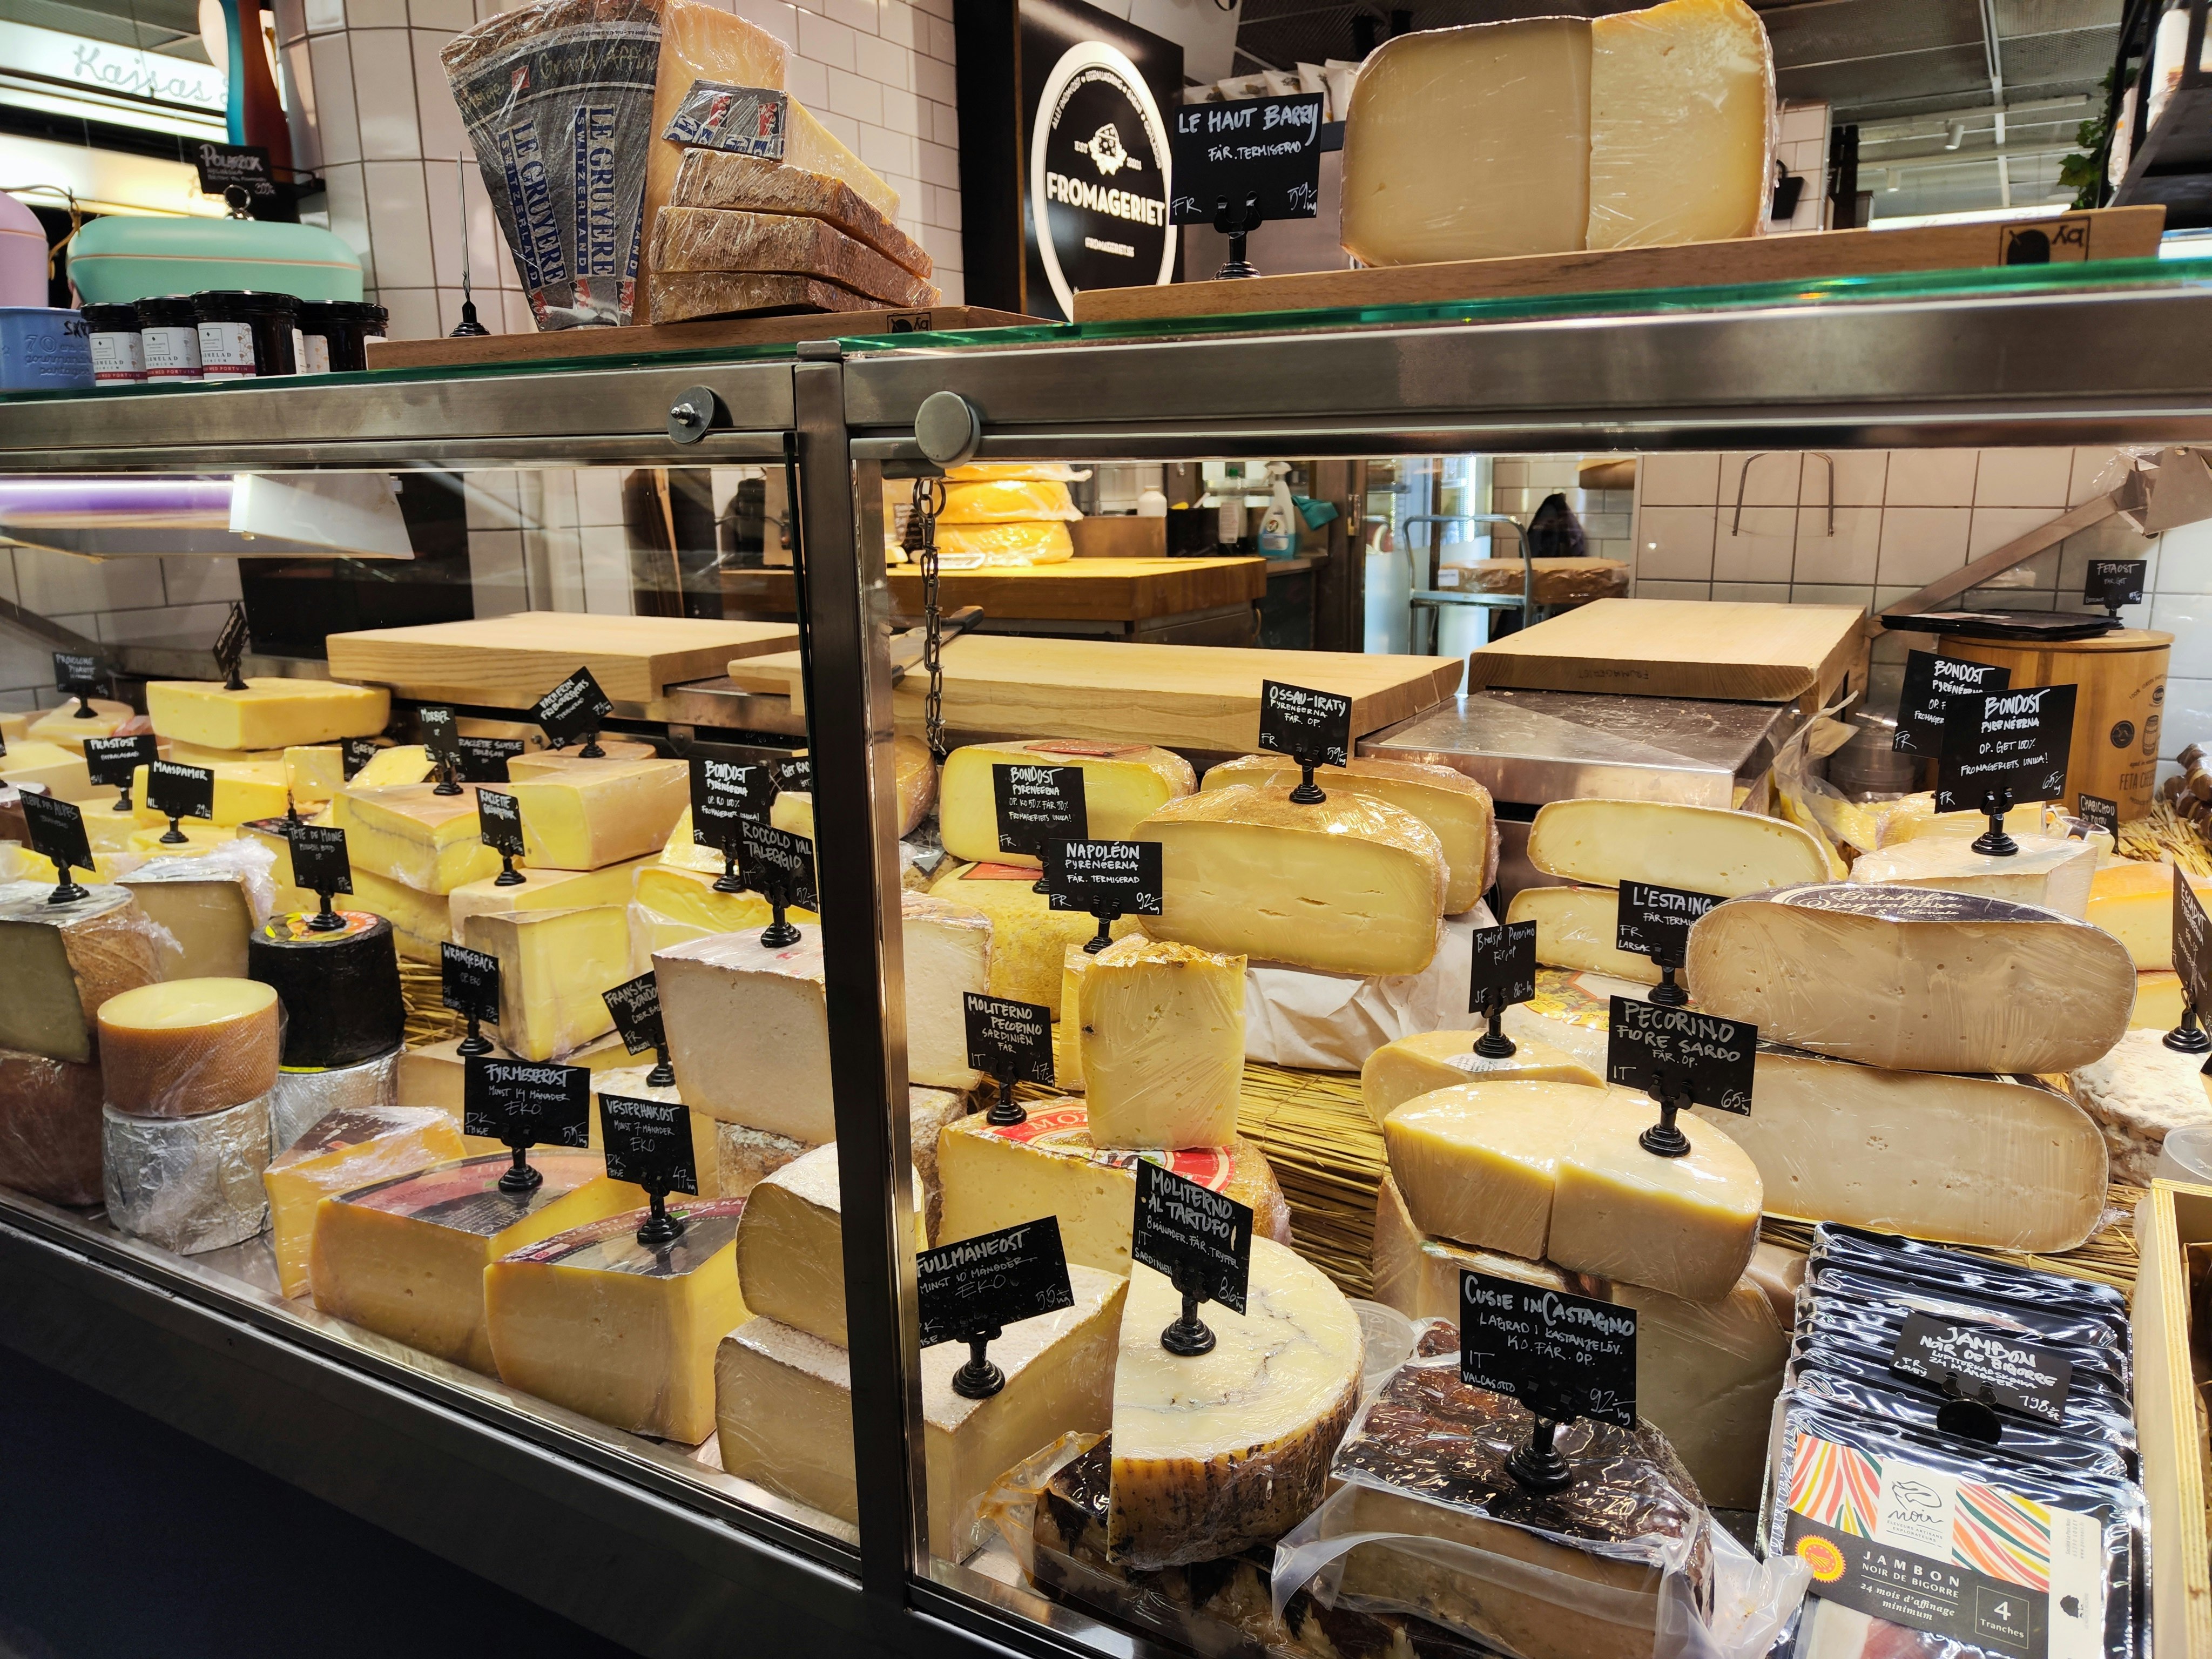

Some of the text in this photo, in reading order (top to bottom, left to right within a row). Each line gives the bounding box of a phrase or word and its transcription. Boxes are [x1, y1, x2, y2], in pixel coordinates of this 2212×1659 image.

[73, 44, 212, 102] Kajsas
[590, 109, 615, 140] LE
[1179, 103, 1319, 146] LE HAUT BARRY
[512, 122, 538, 158] LE
[576, 116, 587, 266] SWITZERLAND
[1047, 171, 1165, 227] FROMAGERIET
[1172, 196, 1202, 216] FR
[1934, 660, 1995, 685] BONDOST
[1269, 685, 1346, 717] OSSAU-IRATY
[1984, 689, 2051, 720] BONDOST
[1307, 718, 1321, 728] OP.
[1261, 733, 1278, 747] FR
[1894, 731, 1917, 750] FR
[1996, 740, 2017, 754] GET
[153, 760, 208, 781] MAASDAMER
[705, 760, 757, 784] BONDOST
[1960, 752, 2049, 777] FROMAGERIETS UNIKA!
[1010, 766, 1064, 785] BONDOST
[2119, 772, 2138, 791] FETA
[147, 797, 159, 809] NL
[1939, 790, 1955, 806] FR
[1008, 811, 1073, 822] FROMAGERIETS UNIKA!
[1000, 834, 1017, 847] FR
[1066, 841, 1141, 860] NAPOLÉON
[743, 840, 802, 871] TALEGGIO
[1066, 873, 1141, 884] FÅR. TERMISERAD
[1050, 894, 1072, 907] FR
[1643, 912, 1664, 924] FÅR
[1620, 925, 1643, 938] FR
[443, 944, 496, 973] WRÅNGEBÄCK
[604, 979, 653, 1009] FRANSK
[967, 995, 1033, 1020] MOLITERNO
[990, 1016, 1043, 1036] PECORINO
[1623, 1001, 1735, 1043] PECORINO
[982, 1028, 1034, 1046] SARDINIEN
[1615, 1024, 1741, 1063] FIORE SARDO
[997, 1041, 1017, 1054] FÅR
[972, 1053, 986, 1067] IT
[1613, 1065, 1637, 1081] IT
[503, 1100, 542, 1116] EKO
[465, 1112, 497, 1125] DK
[633, 1121, 642, 1136] 7
[629, 1136, 656, 1152] EKO
[606, 1154, 626, 1168] DK
[1151, 1168, 1233, 1219] MOLITERNO
[1148, 1192, 1230, 1239] AL TARTUFO
[1138, 1230, 1152, 1246] IT
[916, 1226, 1031, 1278] FULLMÅNEOST
[1134, 1246, 1174, 1276] SARDINIEN
[1209, 1246, 1239, 1270] TRYFFEL
[919, 1276, 951, 1295] MINST
[954, 1273, 1006, 1298] EKO
[1465, 1274, 1514, 1310] CUSIE
[1542, 1291, 1635, 1337] CASTAGNO
[1480, 1312, 1530, 1334] LAGRAD
[1919, 1334, 1985, 1363] NOIR DE
[1936, 1326, 2036, 1368] JAMBON
[1469, 1350, 1495, 1369] IT
[1901, 1357, 1928, 1371] FR
[1928, 1357, 1947, 1367] 24
[1462, 1370, 1516, 1393] VALCASOTTO
[1887, 1509, 1944, 1523] noir
[1892, 1527, 1937, 1542] EXPLORATEURS
[1916, 1528, 1943, 1540] ARTISANS
[1863, 1550, 1960, 1588] JAMBON
[1862, 1563, 1960, 1599] NOIR DE BIGORRE
[1860, 1582, 1956, 1617] 24 mois d'affinage
[1881, 1599, 1933, 1621] minimum
[1994, 1601, 2012, 1621] 4
[1980, 1618, 2025, 1638] Tranches
